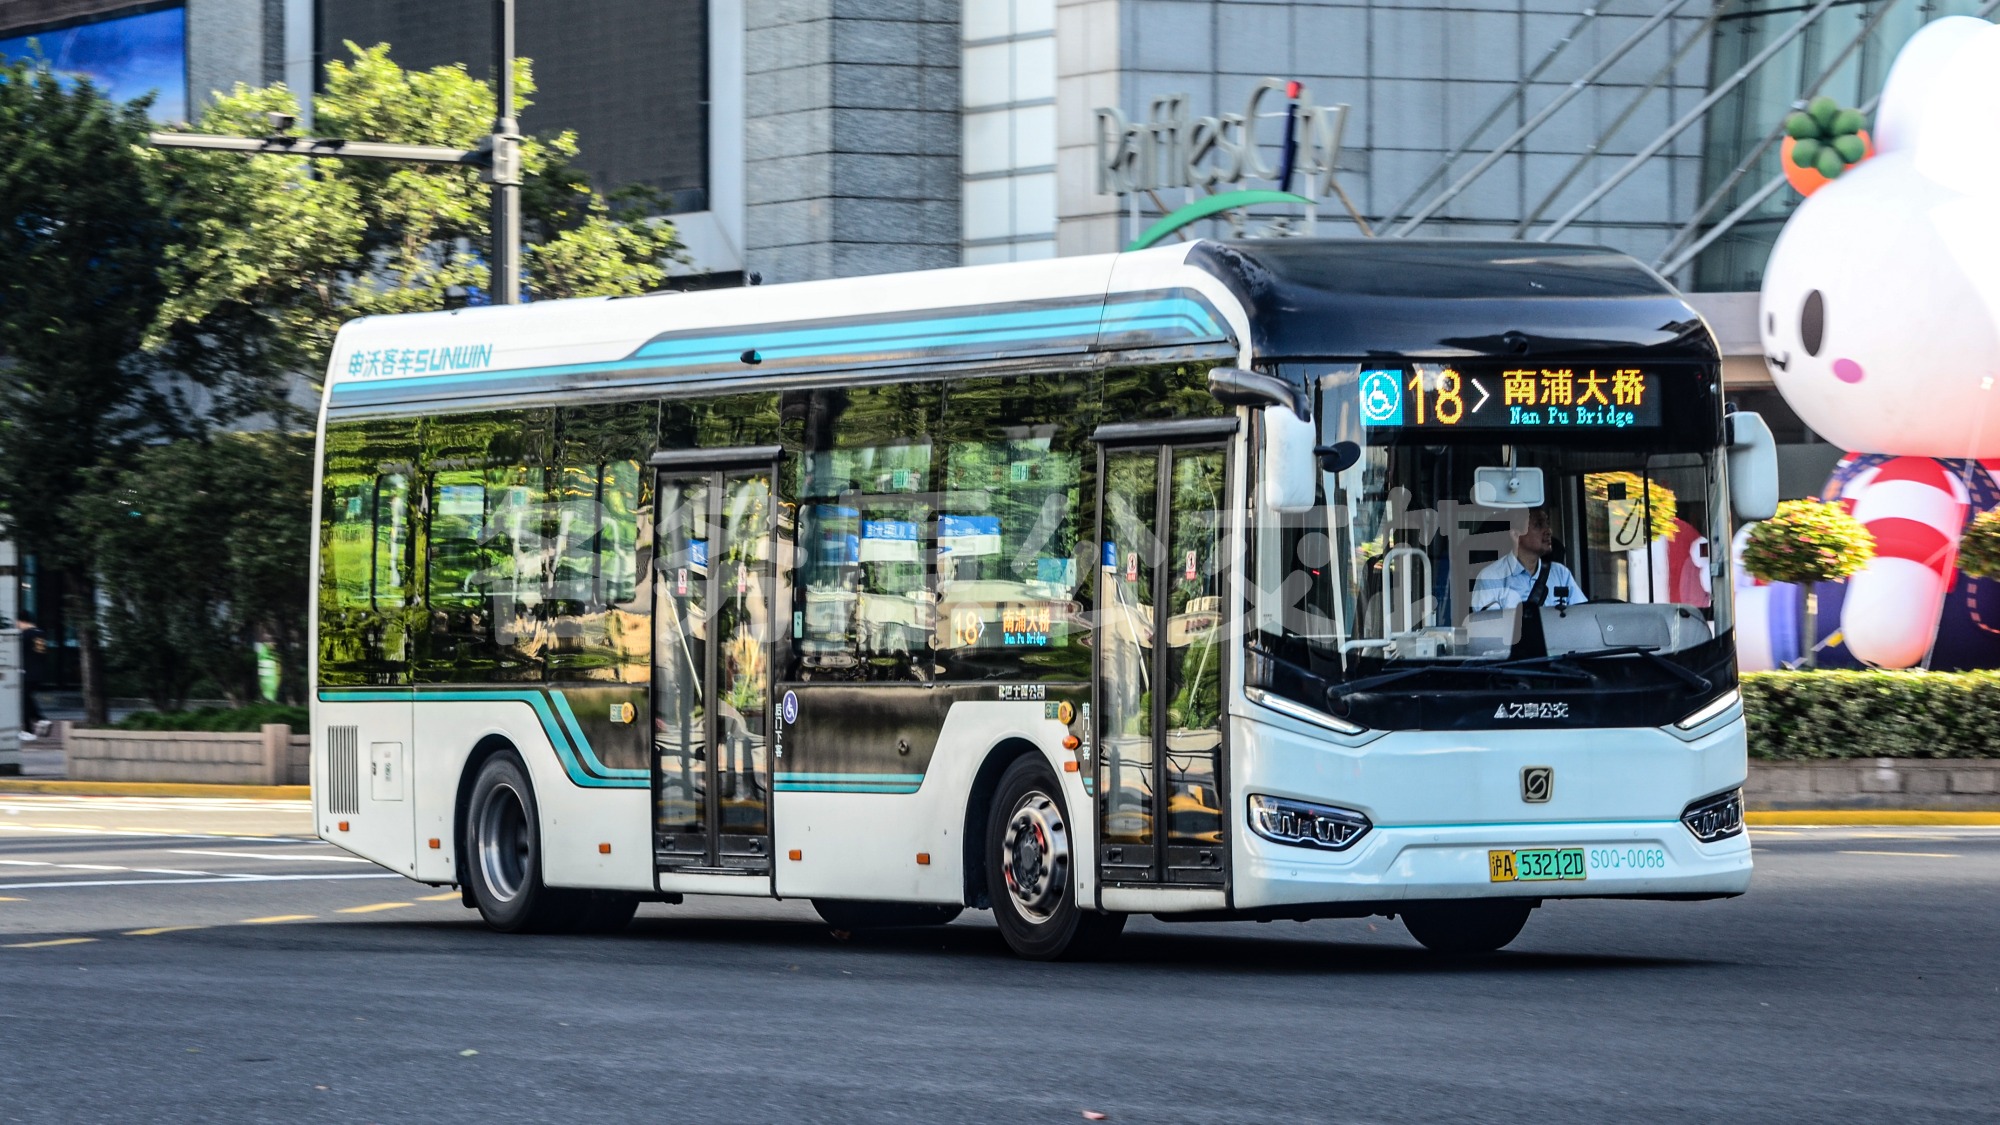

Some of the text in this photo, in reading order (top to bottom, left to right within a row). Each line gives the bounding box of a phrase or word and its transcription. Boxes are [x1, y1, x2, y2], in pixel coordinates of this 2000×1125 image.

[348, 349, 415, 377] 申沃客车
[1408, 369, 1463, 425] 18
[1502, 369, 1646, 405] 南浦大桥
[1510, 405, 1634, 427] Nan Pu Bridge
[955, 611, 978, 645] 18
[1002, 608, 1050, 633] 南浦大桥
[1082, 702, 1091, 760] 前门上客
